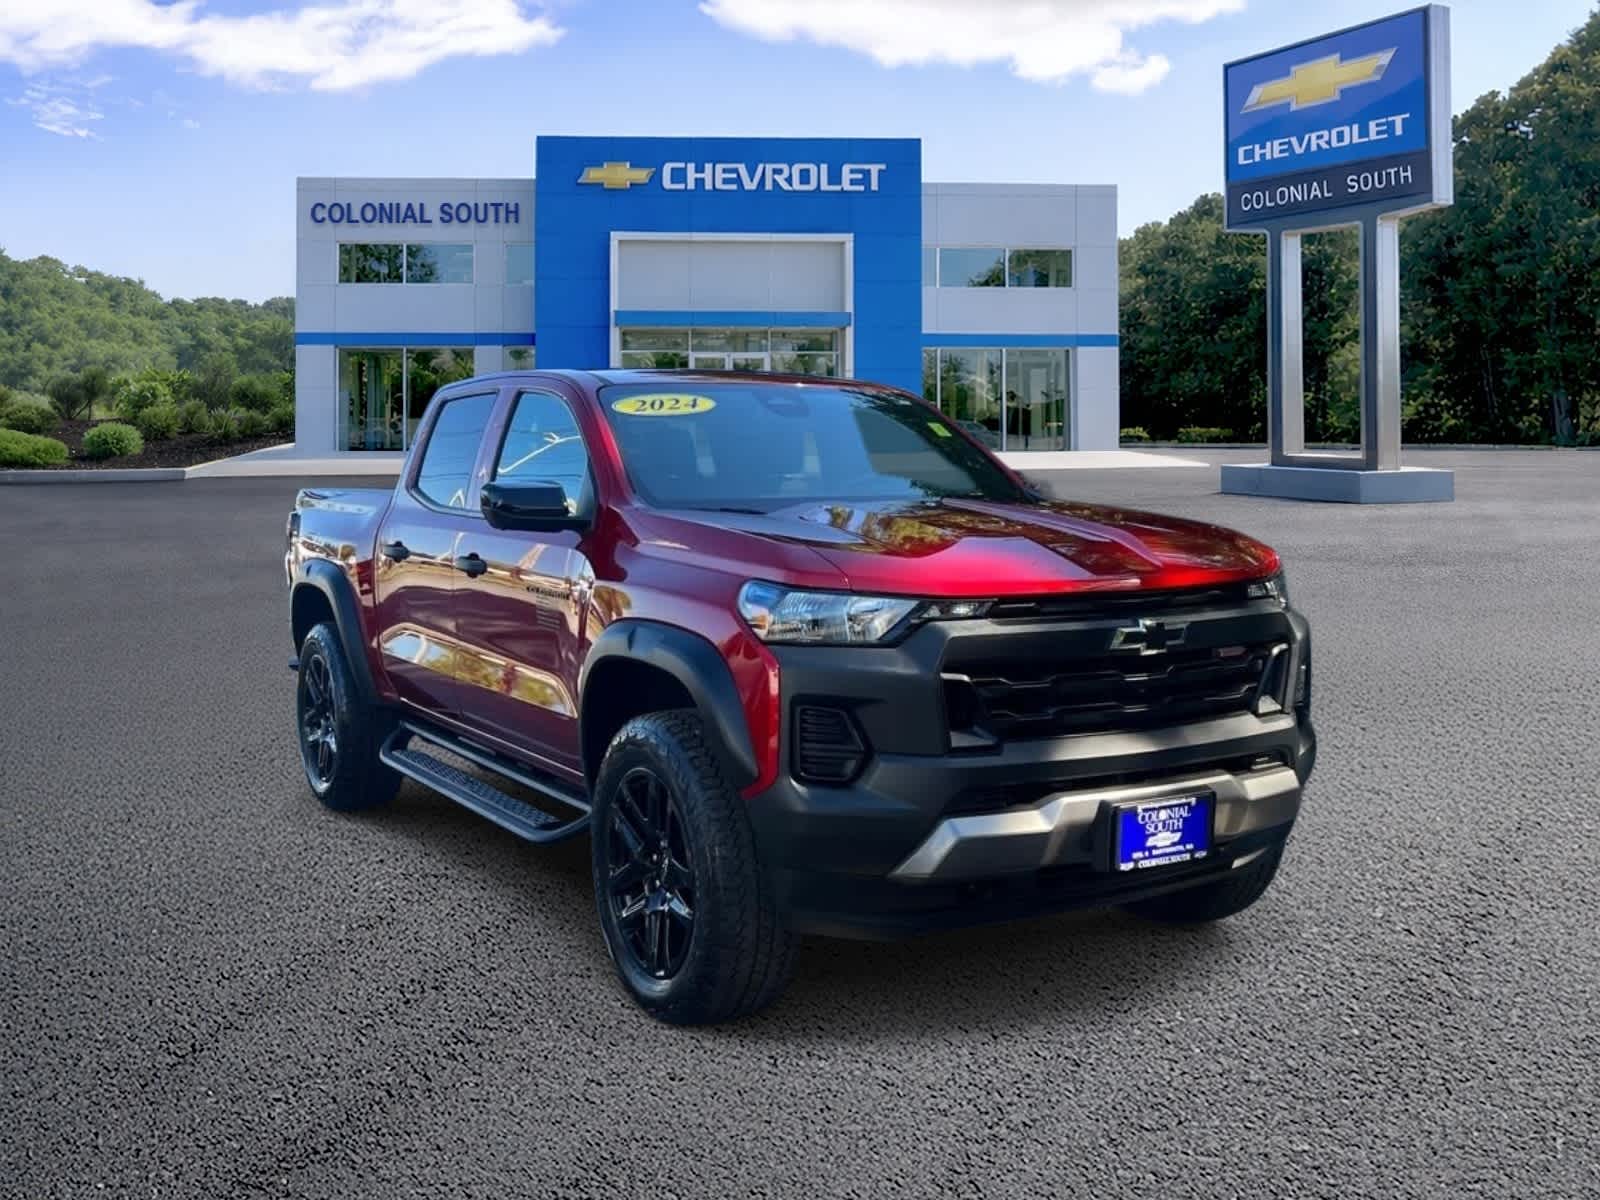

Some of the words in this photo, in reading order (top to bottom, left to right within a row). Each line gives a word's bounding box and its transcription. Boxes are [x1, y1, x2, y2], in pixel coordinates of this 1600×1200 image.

[1237, 113, 1410, 165] CHEVROLET
[661, 161, 887, 192] CHEVROLET
[1240, 180, 1333, 211] COLONIAL
[1346, 165, 1412, 193] SOUTH
[310, 202, 432, 225] COLONIAL
[438, 201, 520, 225] SOUTH
[634, 397, 699, 413] 2024
[1138, 805, 1191, 825] COLONIAL
[1145, 818, 1183, 834] SOUTH
